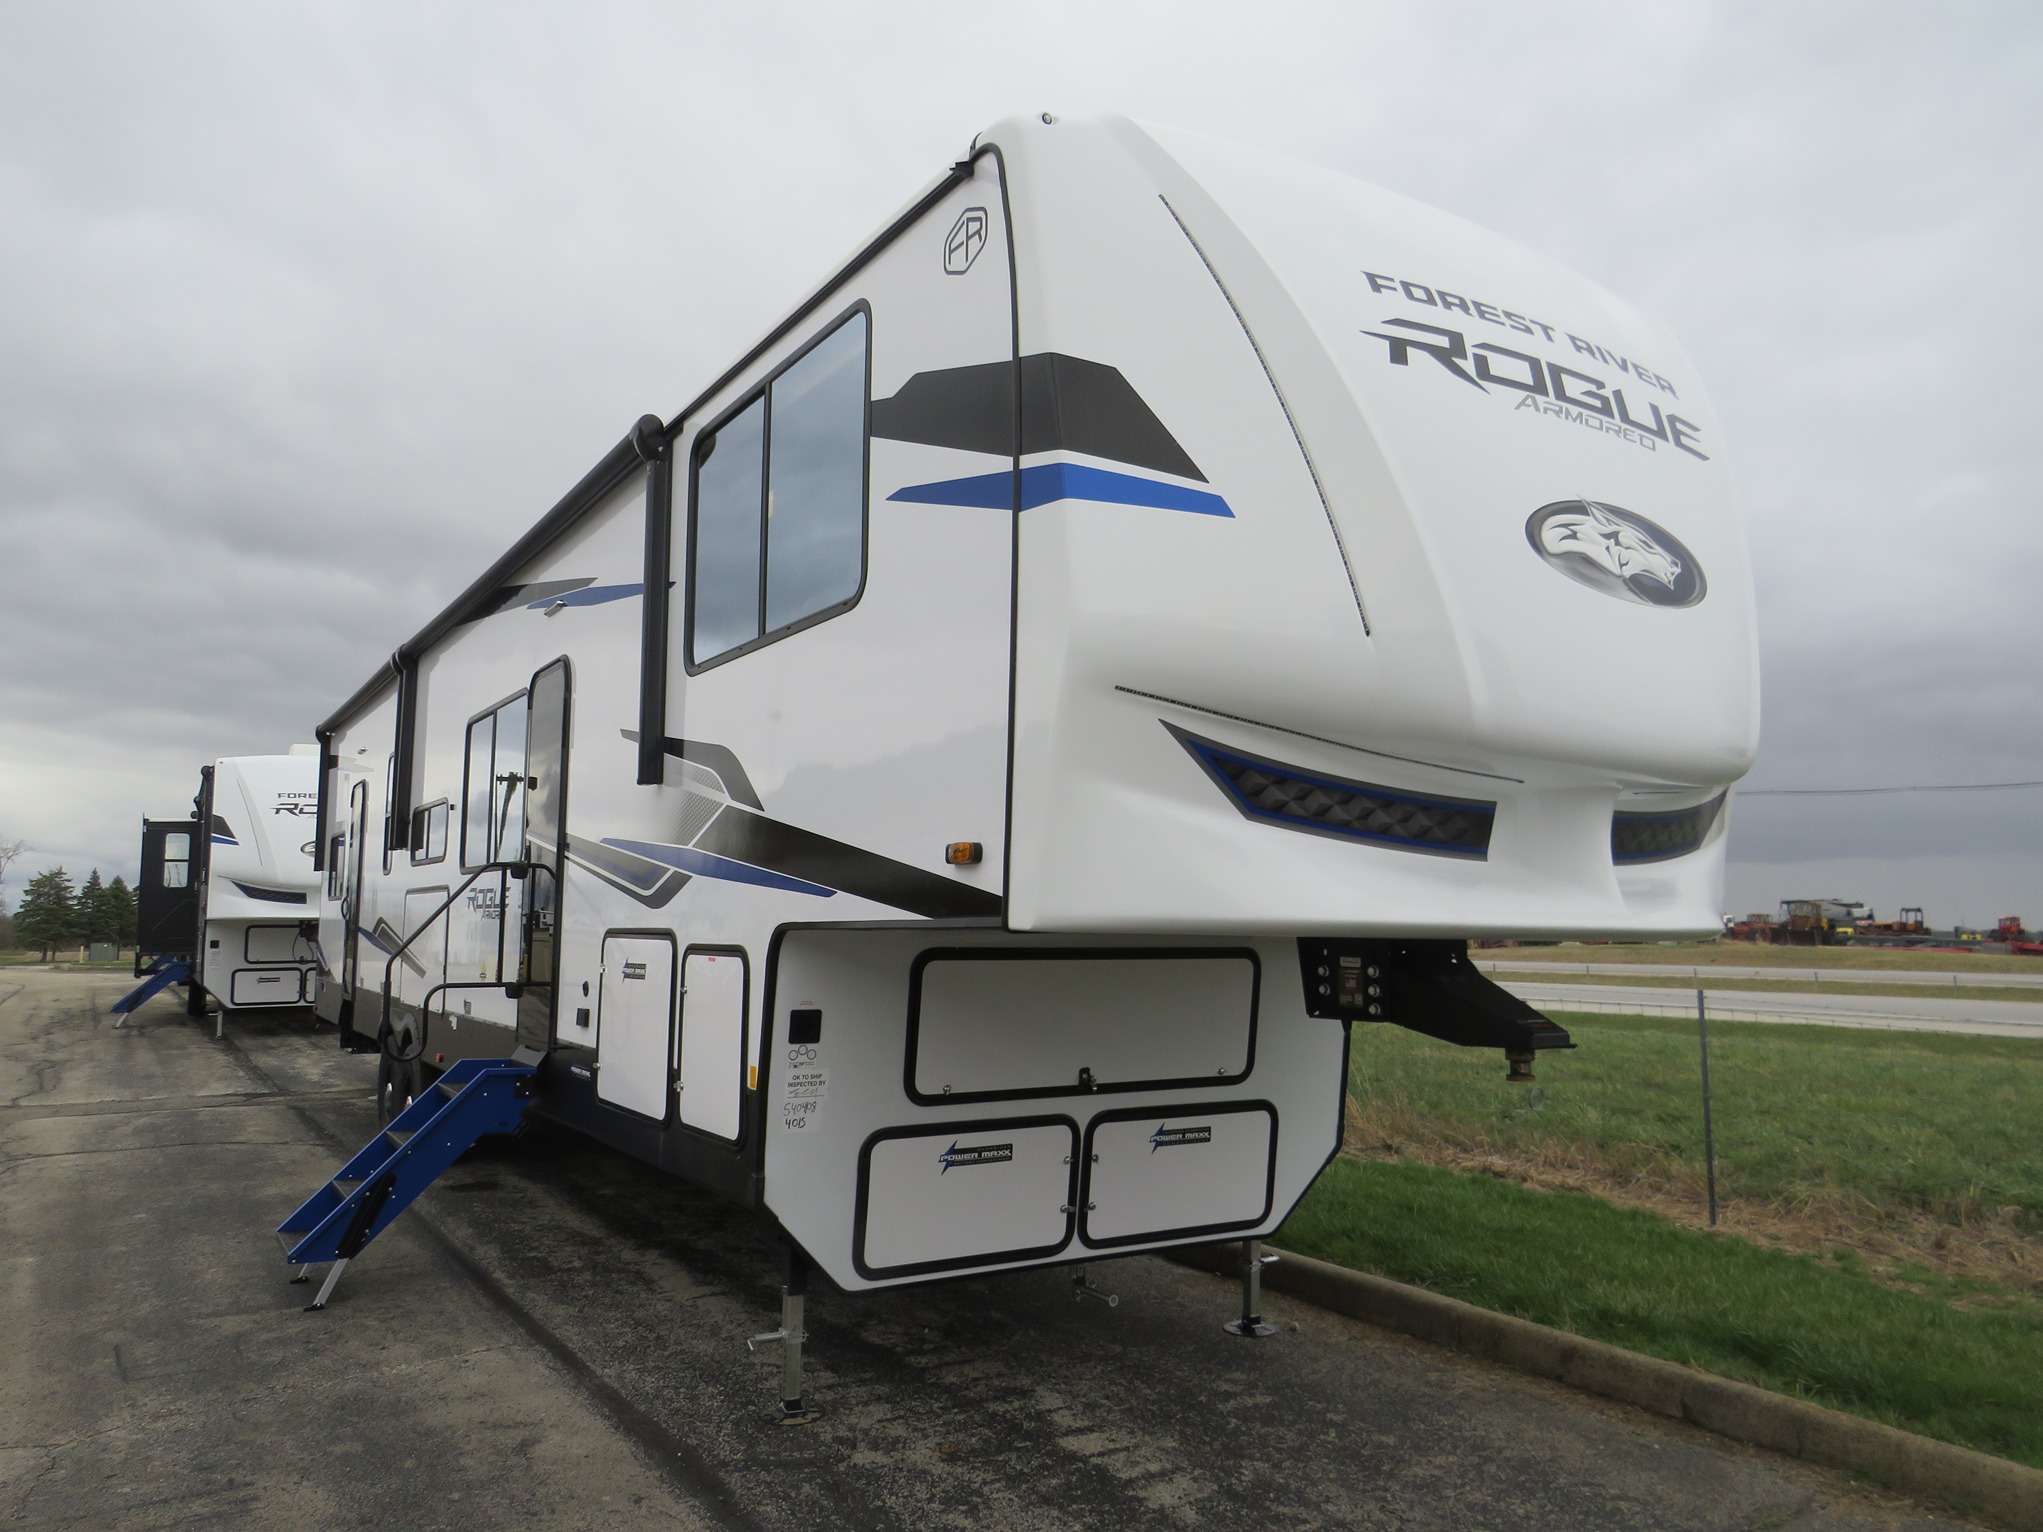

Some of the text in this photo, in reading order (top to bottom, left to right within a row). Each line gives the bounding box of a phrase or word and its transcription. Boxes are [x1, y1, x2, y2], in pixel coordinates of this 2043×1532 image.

[1360, 270, 1681, 401] FOREST RIVER
[1359, 317, 1711, 461] ROGUE
[1513, 394, 1656, 452] ARMORED
[939, 1152, 979, 1162] POWER
[981, 1149, 1012, 1159] MAXX
